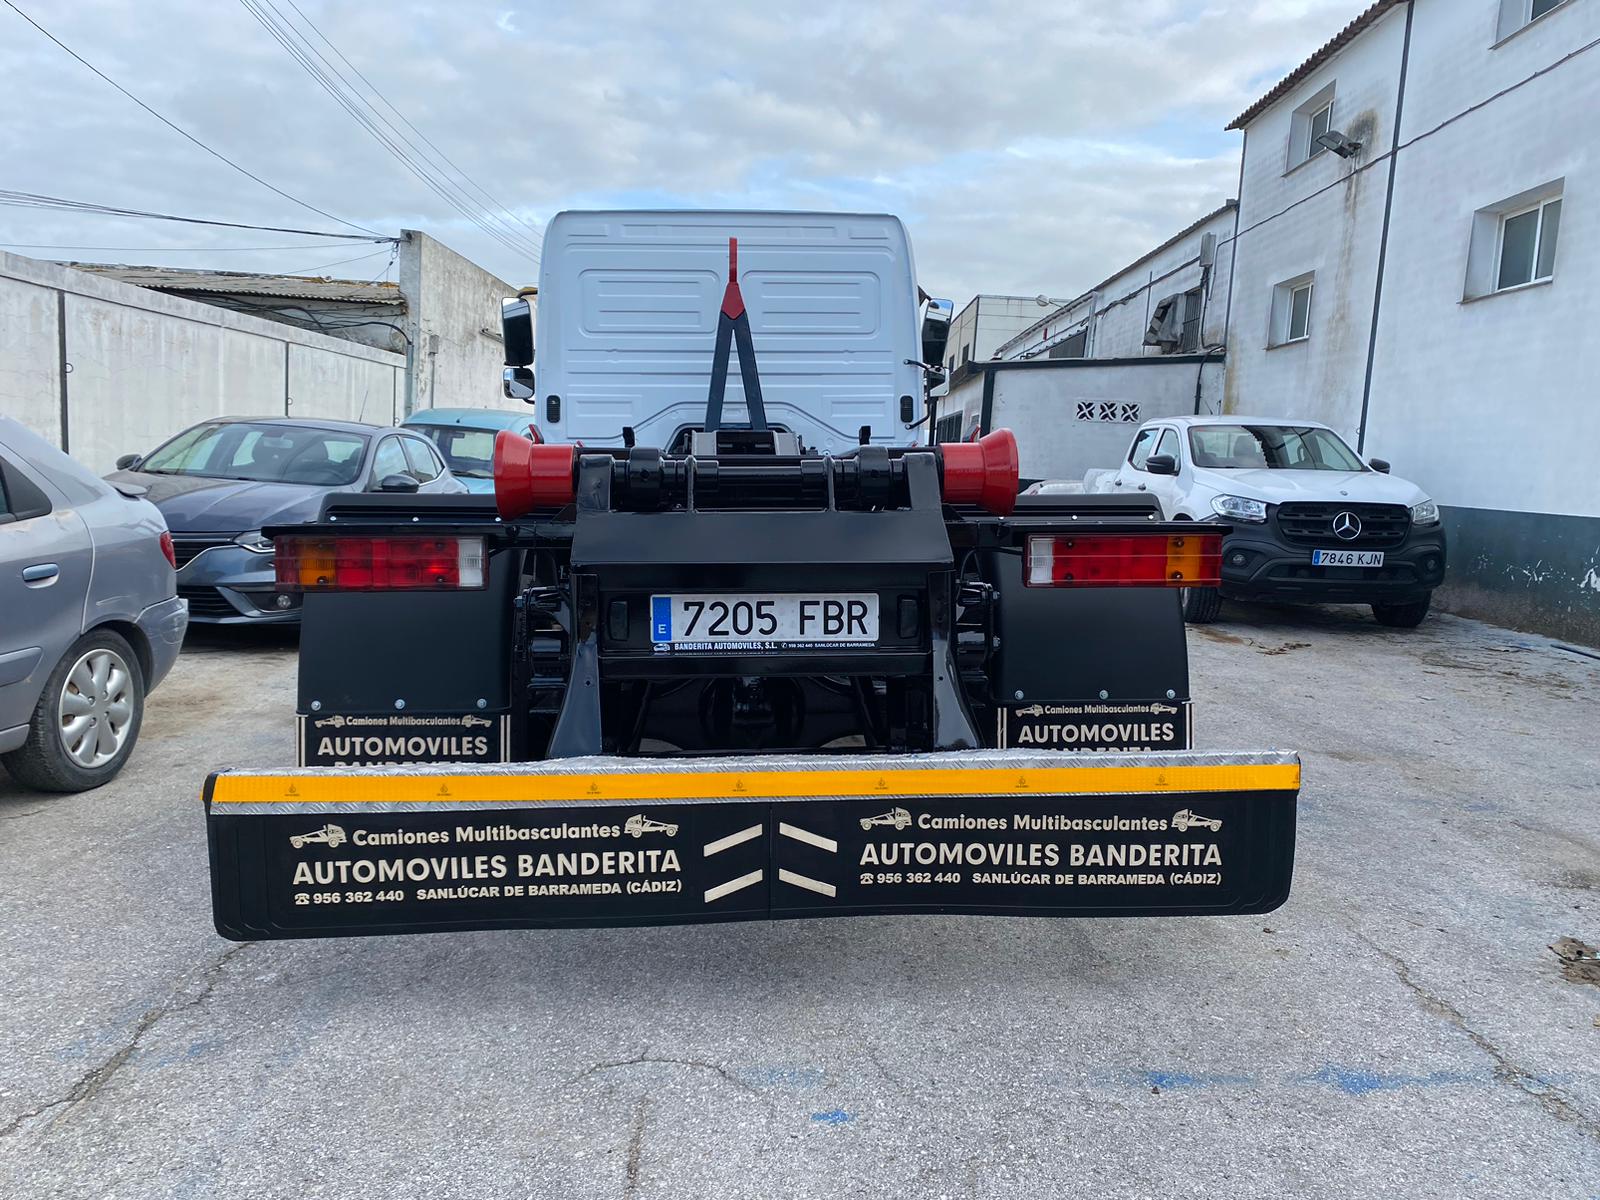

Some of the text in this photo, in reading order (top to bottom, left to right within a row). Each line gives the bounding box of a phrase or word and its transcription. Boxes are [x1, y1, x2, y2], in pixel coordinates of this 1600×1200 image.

[1321, 552, 1382, 565] 7846 KJN
[683, 600, 869, 637] 7205 FBR
[658, 624, 666, 634] E
[674, 641, 778, 651] BANDERITA AUTOMOVILES, S.L.
[1044, 704, 1150, 715] Camiones Multibasculantes
[346, 715, 461, 726] Camiones Multibasculantes
[1018, 723, 1175, 744] AUTOMOVILES
[317, 736, 489, 757] AUTOMOVILES
[918, 813, 1168, 832] Camiones Multibasculantes
[352, 821, 621, 848] Camiones Multibasculantes
[859, 842, 1223, 868] AUTOMOVILES BANDERITA
[292, 848, 682, 885] AUTOMOVILES BANDERITA
[876, 870, 1223, 887] 956 362 440 SANLÚCAR DE BARRAMEDA (CÁDIZ)
[312, 878, 683, 905] 956 362 440 SANLÚCAR DE BARRAMEDA (CÁDIZ)
